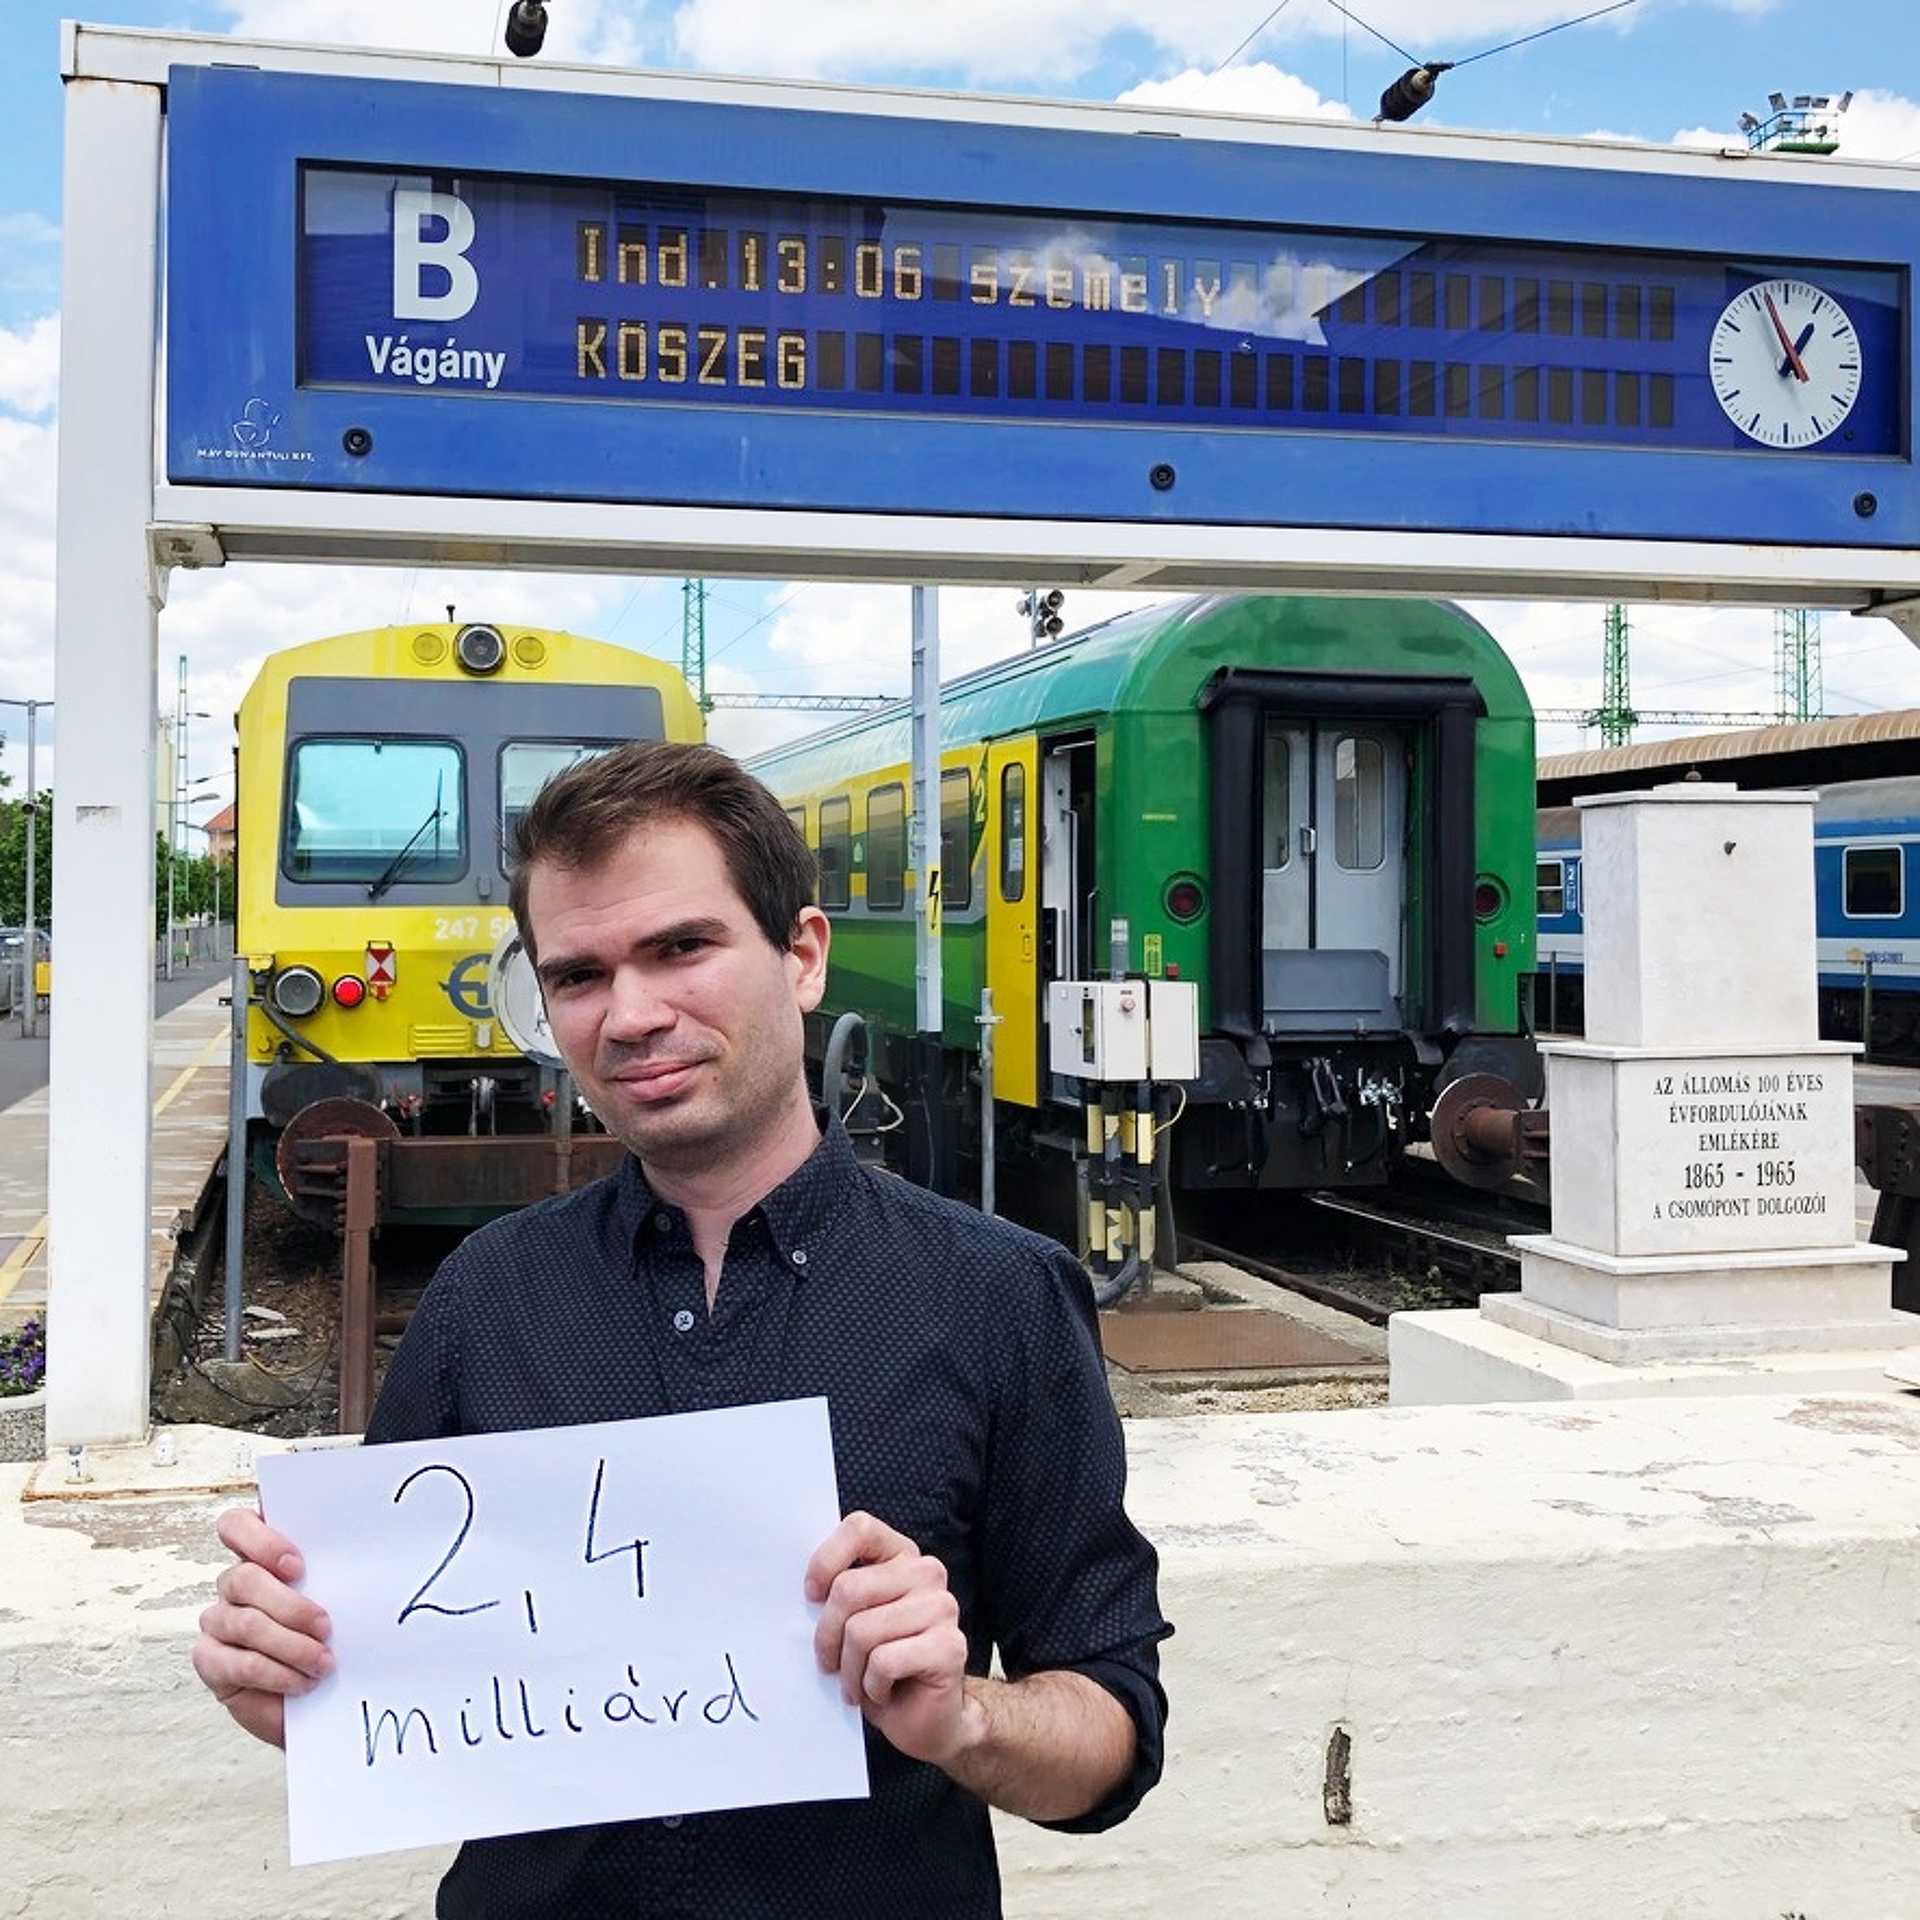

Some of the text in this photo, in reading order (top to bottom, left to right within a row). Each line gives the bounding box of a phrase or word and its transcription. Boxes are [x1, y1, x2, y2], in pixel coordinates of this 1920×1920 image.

[394, 190, 480, 321] B
[365, 335, 505, 388] Vágány
[435, 917, 479, 940] 247
[1653, 1070, 1824, 1095] AZ ÁLLOMÁS 100 ÉVES
[1669, 1099, 1808, 1124] ÉVFORDULÓJÁNAK
[1698, 1129, 1780, 1151] EMLÉKÉRE
[1685, 1163, 1724, 1189] 1865
[1756, 1160, 1796, 1187] 1965
[1653, 1192, 1826, 1219] A CSOMÓPONT DOLGOZÓI
[361, 1652, 760, 1767] milliárd
